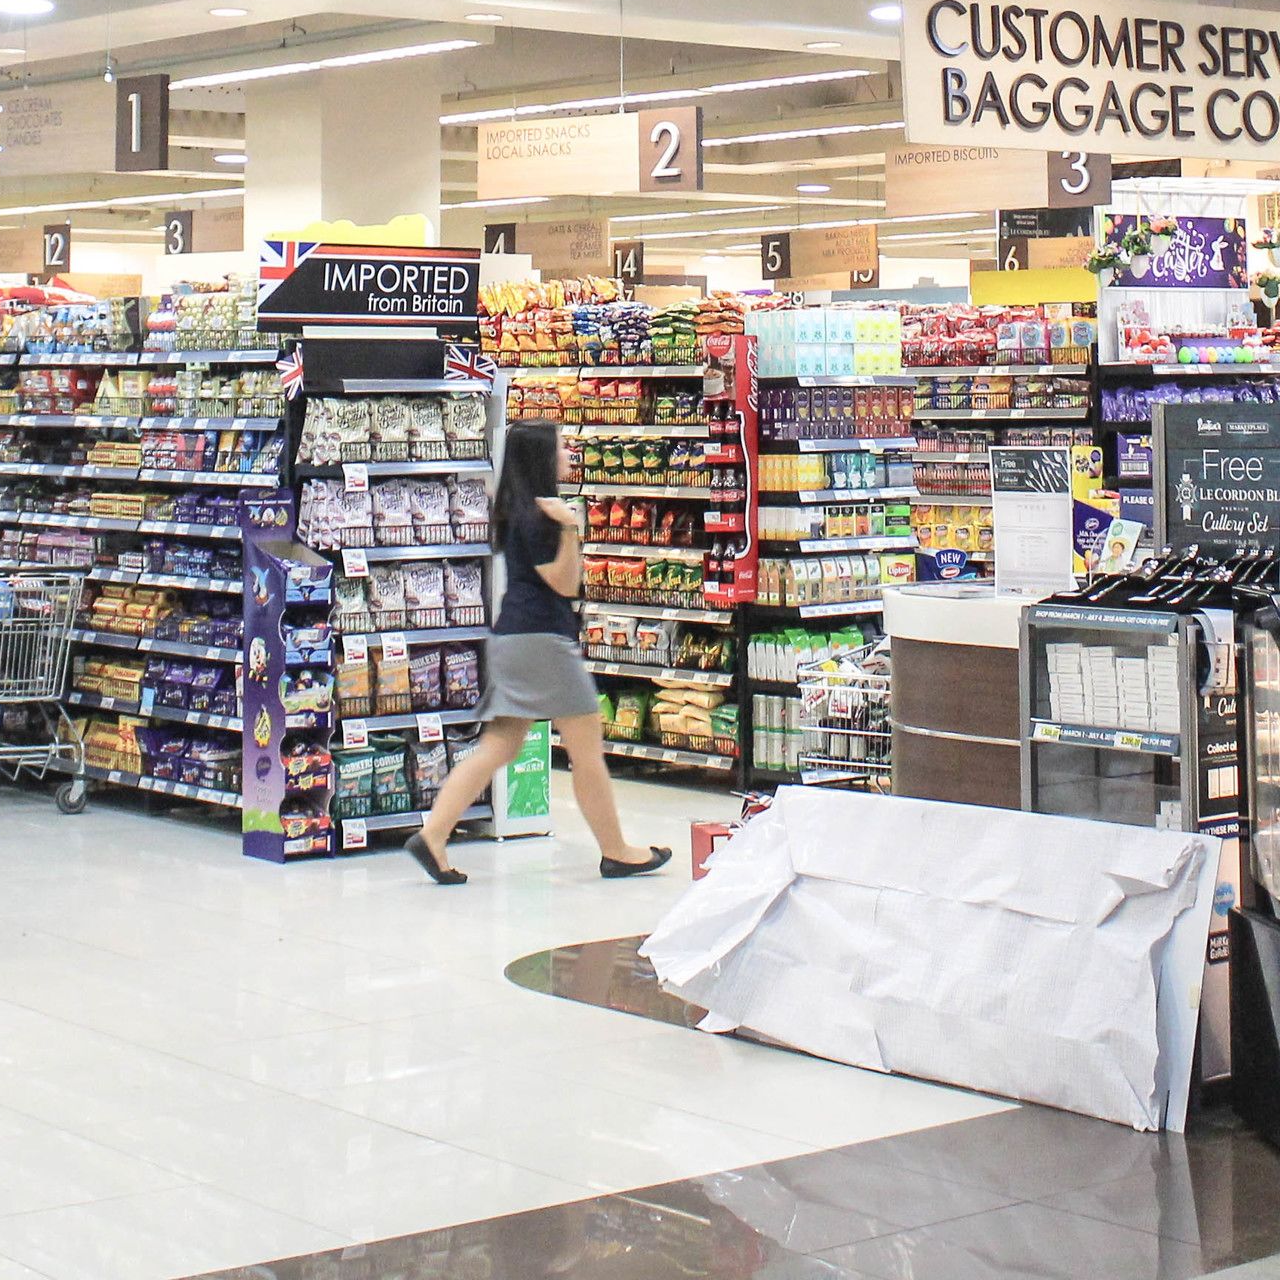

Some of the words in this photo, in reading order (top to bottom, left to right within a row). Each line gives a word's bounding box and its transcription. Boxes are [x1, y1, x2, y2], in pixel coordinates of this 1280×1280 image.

[926, 0, 1186, 74] CUSTOMER
[942, 67, 1196, 138] BAGGAGE
[127, 93, 142, 153] 1
[486, 127, 542, 144] IMPORTED
[545, 123, 591, 140] SNACKS
[486, 145, 524, 160] LOCAL
[526, 141, 572, 157] SNACKS
[650, 121, 682, 178] 2
[894, 148, 951, 165] IMPORTED
[953, 146, 999, 162] BISCUITS
[1060, 151, 1091, 194] 3
[44, 233, 65, 266] 12
[168, 219, 185, 255] 3
[614, 249, 637, 278] 14
[766, 241, 782, 272] 5
[1004, 246, 1019, 271] 6
[323, 261, 470, 295] IMPORTED
[367, 293, 409, 313] from
[412, 294, 464, 315] Britain
[1202, 449, 1263, 482] Free
[1123, 495, 1148, 505] PLEASE
[1199, 488, 1214, 501] LE
[1214, 488, 1265, 502] CORDON
[888, 566, 909, 577] Lipton
[940, 552, 961, 564] NEW
[1207, 742, 1228, 754] Collect
